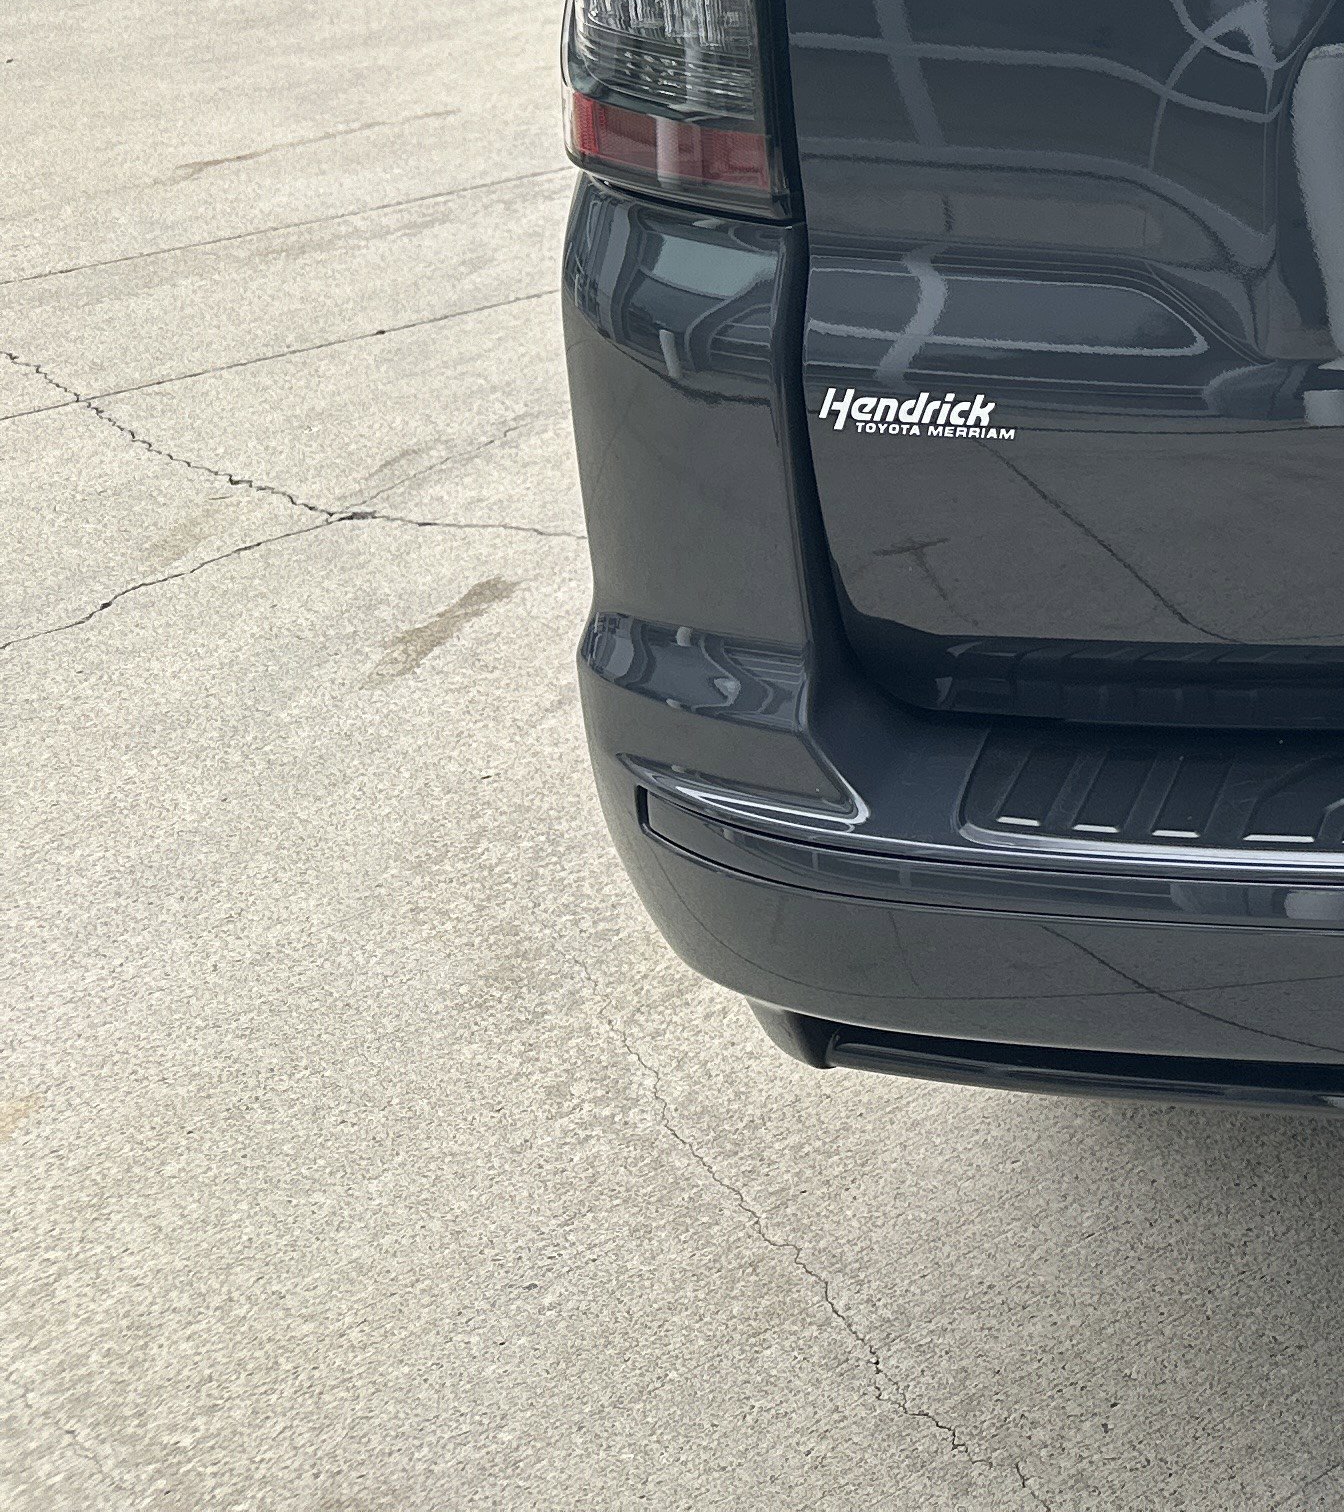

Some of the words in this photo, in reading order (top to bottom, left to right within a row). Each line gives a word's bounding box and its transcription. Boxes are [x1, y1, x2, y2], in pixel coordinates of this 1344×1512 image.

[818, 387, 996, 431] Hendrick
[855, 421, 920, 436] TOYOTA
[927, 425, 1016, 440] MERRIAM
